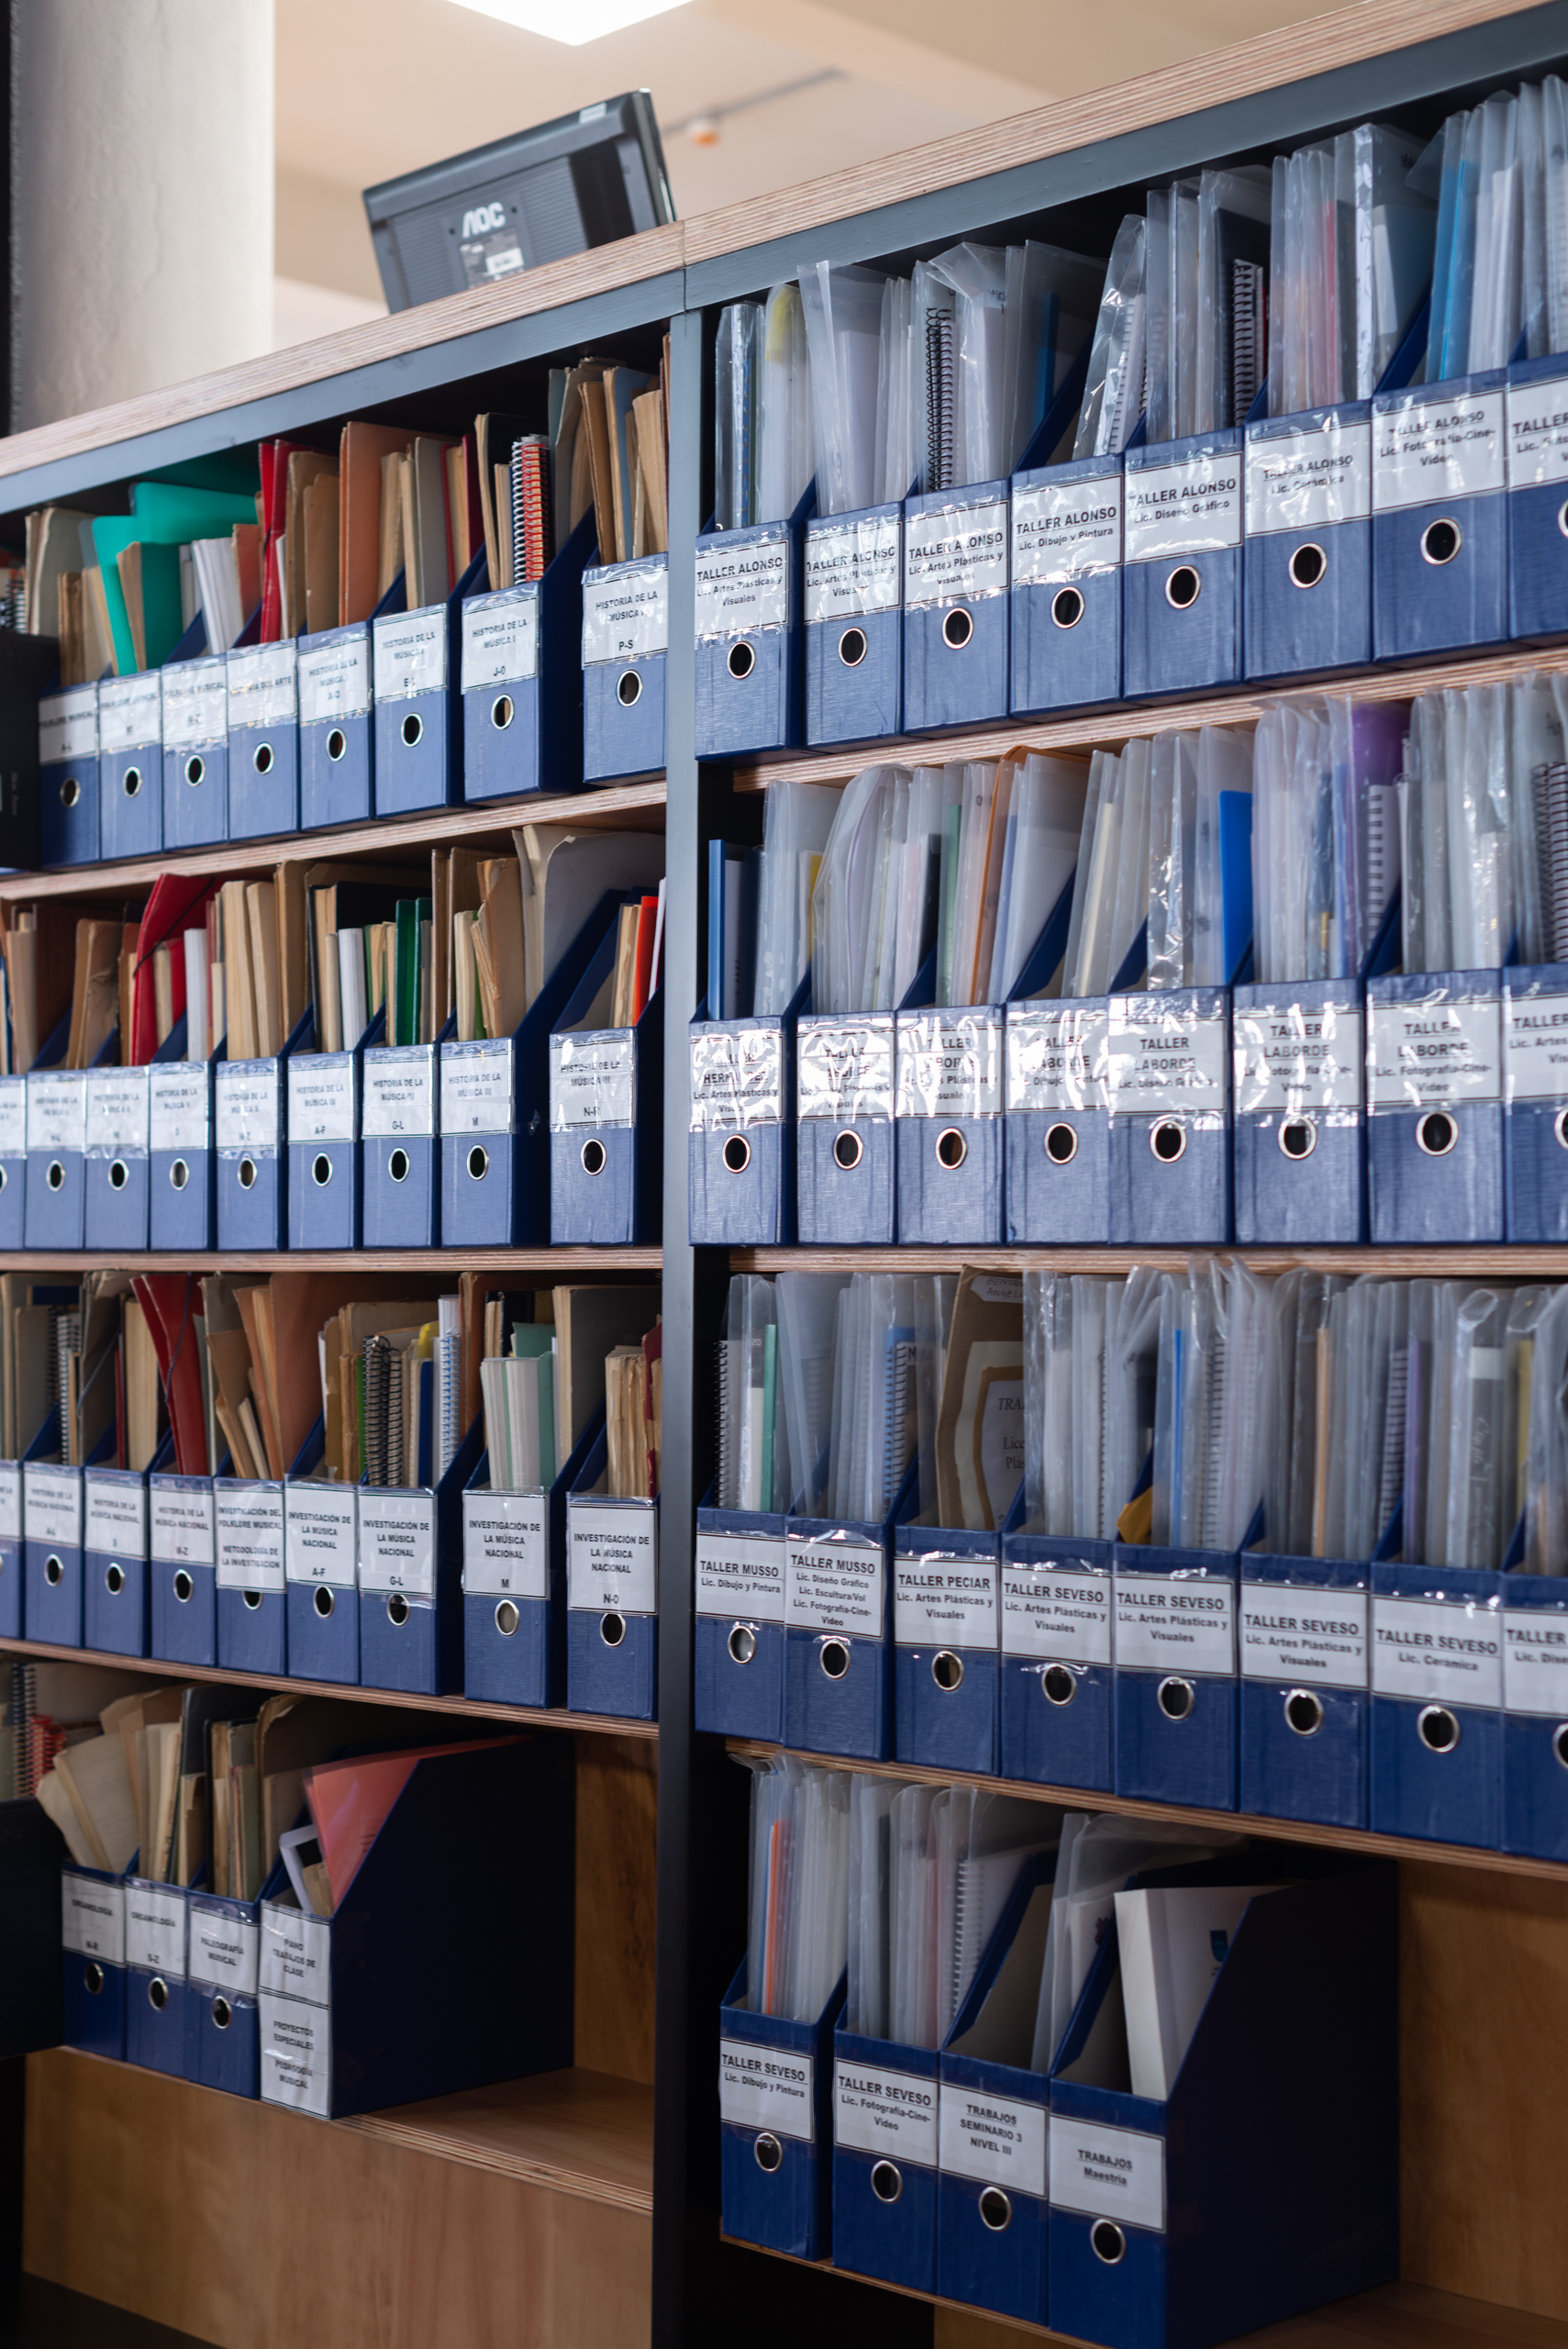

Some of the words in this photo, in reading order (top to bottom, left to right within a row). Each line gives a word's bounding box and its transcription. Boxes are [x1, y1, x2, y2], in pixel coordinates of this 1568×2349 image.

[462, 201, 506, 239] AOC
[1181, 477, 1236, 499] ALONSO
[1016, 516, 1061, 535] TALLER
[1064, 507, 1117, 527] ALONSO
[697, 565, 736, 583] TALLER
[739, 556, 784, 575] ALONSO
[635, 593, 645, 603] DE
[647, 590, 658, 600] LA
[507, 620, 517, 630] DE
[517, 618, 528, 629] LA
[618, 640, 634, 651] P-S
[1140, 1037, 1189, 1051] TALLER
[342, 1515, 351, 1524] DE
[419, 1522, 430, 1531] DE
[302, 1525, 311, 1533] LA
[530, 1523, 541, 1531] DE
[302, 1539, 337, 1550] NACIONAL
[377, 1533, 386, 1542] LA
[484, 1534, 494, 1543] LA
[638, 1536, 651, 1545] DE
[378, 1547, 416, 1558] NACIONAL
[484, 1548, 524, 1559] NACIONAL
[590, 1548, 601, 1557] LA
[312, 1566, 326, 1577] A-F
[591, 1563, 632, 1574] NACIONAL
[700, 1561, 739, 1575] TALLER
[742, 1564, 779, 1577] MUSSO
[791, 1554, 833, 1570] TALLER
[836, 1560, 875, 1575] MUSSO
[389, 1575, 405, 1586] G-L
[501, 1578, 509, 1588] M
[796, 1573, 810, 1582] Lic.
[898, 1574, 943, 1587] TALLER
[948, 1576, 991, 1589] PECIAR
[701, 1577, 717, 1587] Lic.
[717, 1579, 744, 1591] Dibujo
[745, 1584, 751, 1592] y
[752, 1582, 782, 1594] Pintura
[799, 1586, 814, 1596] Lic.
[1005, 1583, 1051, 1598] TALLER
[1054, 1586, 1105, 1603] SEVESO
[794, 1599, 808, 1609] Lic.
[896, 1592, 914, 1602] Lic.
[916, 1593, 942, 1604] Artes
[986, 1598, 993, 1609] y
[1117, 1592, 1166, 1607] TALLER
[1170, 1595, 1225, 1611] SEVESO
[926, 1609, 965, 1620] Visuales
[1006, 1602, 1023, 1612] Lic.
[1025, 1603, 1052, 1615] Artes
[1099, 1612, 1107, 1622] y
[821, 1616, 844, 1627] Video
[1034, 1620, 1076, 1633] Visuales
[1118, 1612, 1137, 1622] Lic.
[1139, 1613, 1167, 1625] Artes
[1220, 1620, 1229, 1631] y
[1244, 1614, 1297, 1631] TALLER
[1300, 1619, 1360, 1636] SEVESO
[1150, 1630, 1195, 1644] Visuales
[1376, 1629, 1434, 1647] TALLER
[1437, 1635, 1498, 1655] SEVESO
[1507, 1629, 1567, 1645] TALLER
[1245, 1634, 1266, 1645] Lic.
[1268, 1636, 1299, 1649] Artes
[1354, 1645, 1363, 1657] y
[1279, 1653, 1328, 1668] Visuales
[722, 2054, 762, 2073] TALLER
[764, 2062, 806, 2082] SEVESO
[725, 2072, 740, 2084] Lic.
[741, 2076, 768, 2090] Dibujo
[769, 2082, 775, 2092] y
[776, 2084, 806, 2099] Pintura
[839, 2076, 883, 2095] TALLER
[884, 2086, 931, 2107] SEVESO
[841, 2095, 859, 2107] Lic.
[966, 2104, 1018, 2126] TRABAJOS
[873, 2116, 899, 2132] Video
[960, 2119, 1014, 2142] SEMINARIO
[1015, 2133, 1023, 2143] 3
[970, 2137, 1000, 2154] NIVEL
[1002, 2144, 1012, 2156] III
[1076, 2149, 1134, 2171] TRABAJOS
